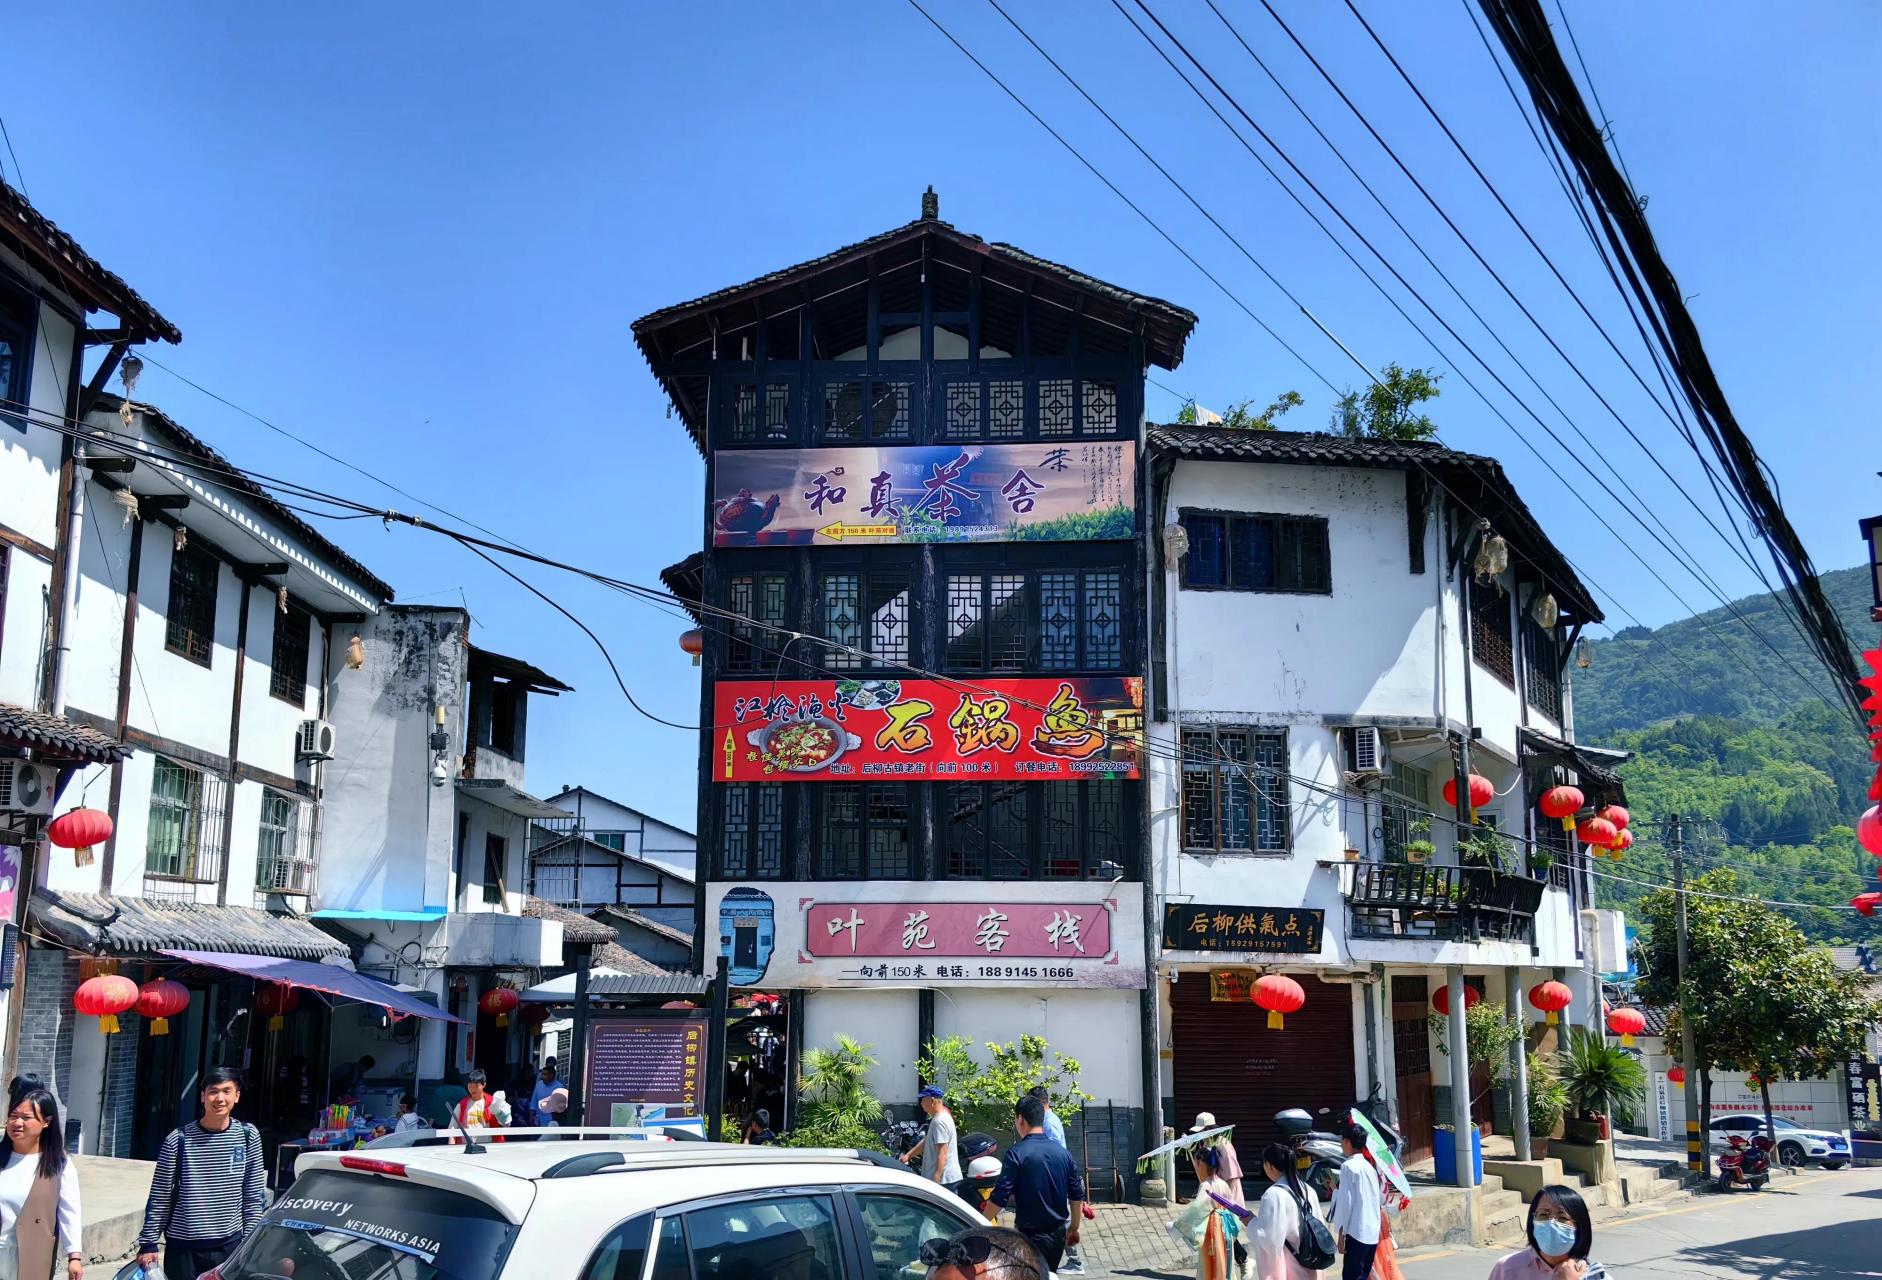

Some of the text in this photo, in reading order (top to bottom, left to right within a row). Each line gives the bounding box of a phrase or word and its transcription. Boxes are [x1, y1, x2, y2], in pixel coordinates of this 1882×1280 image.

[804, 452, 1046, 523] 和真茶舍
[827, 908, 1085, 953] 叶苑客栈
[978, 966, 1001, 978] 188
[1005, 966, 1037, 978] 9145
[1042, 967, 1074, 978] 1666
[344, 1218, 409, 1243] NETWORKS
[407, 1236, 441, 1254] ASIA
